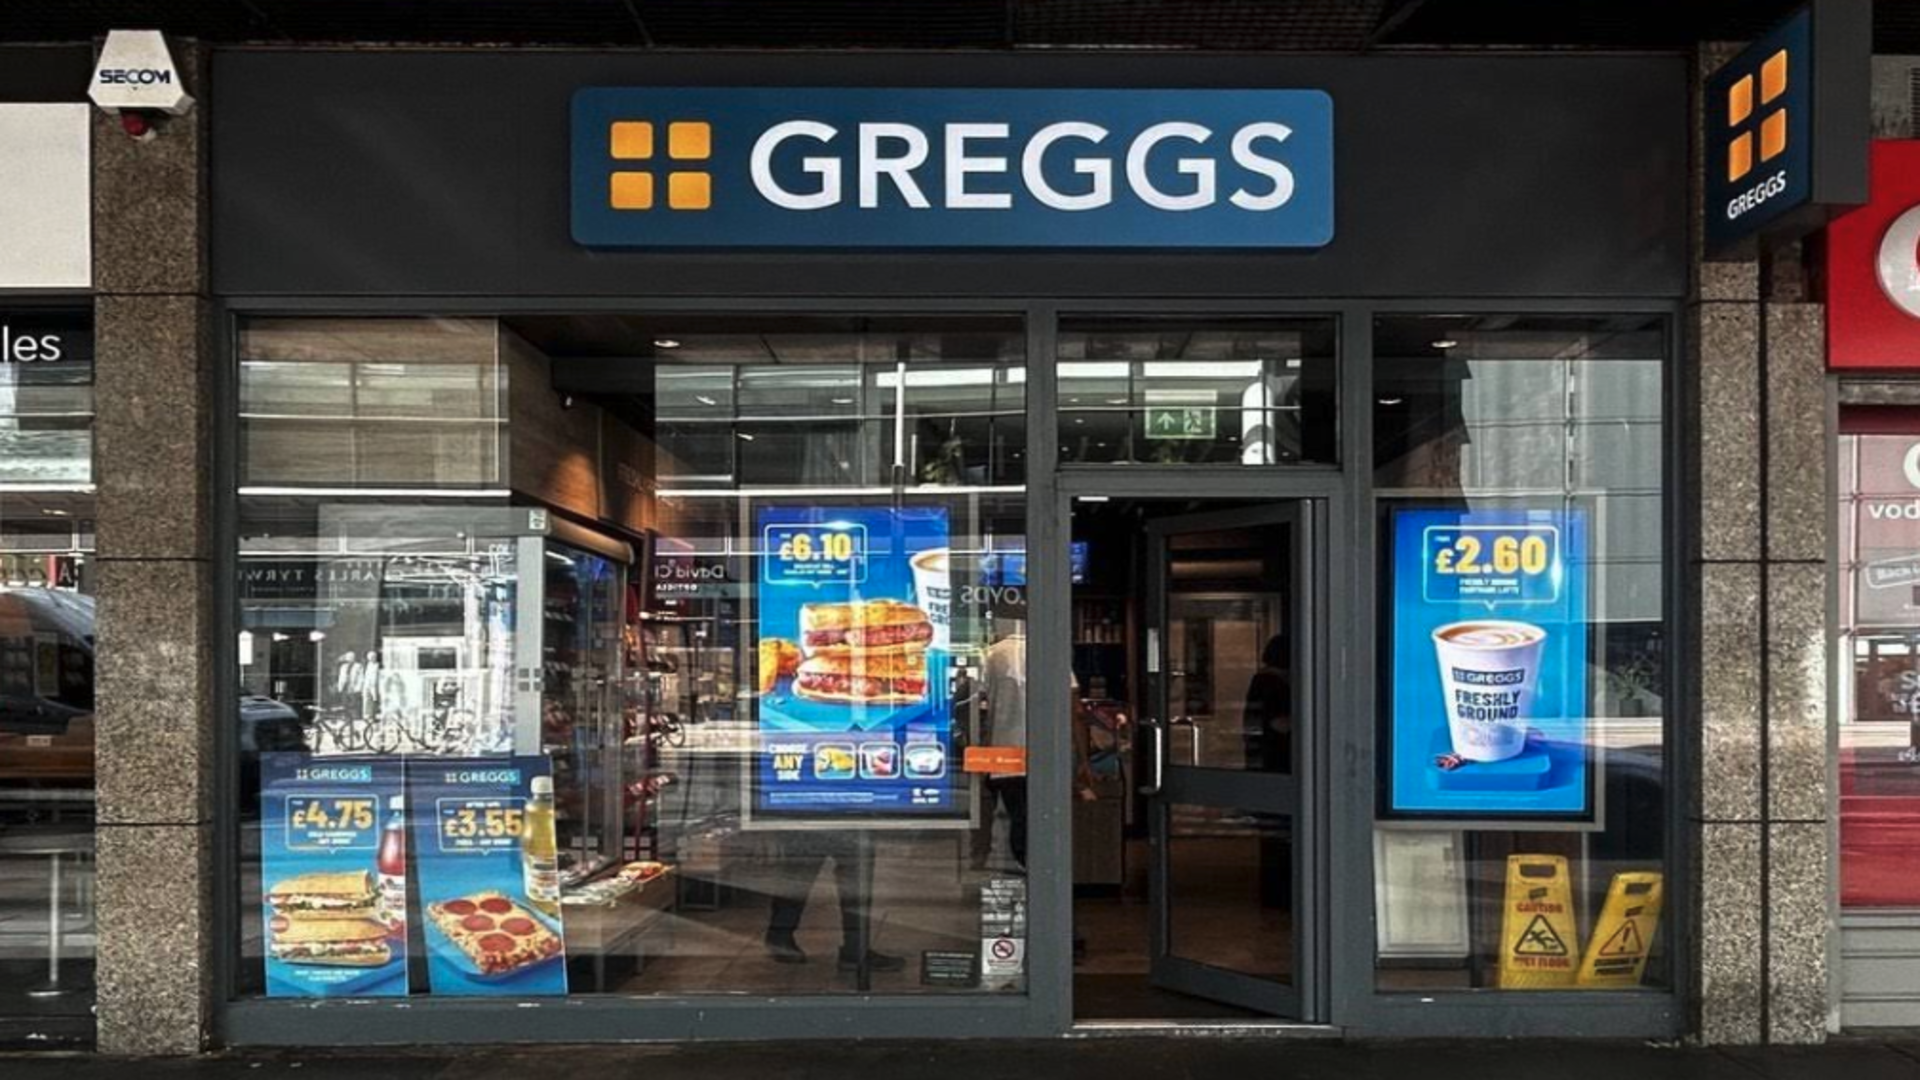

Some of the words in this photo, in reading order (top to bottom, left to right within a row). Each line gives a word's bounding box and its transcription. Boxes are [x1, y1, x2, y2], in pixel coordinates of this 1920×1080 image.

[99, 69, 171, 84] SECOM
[750, 120, 1295, 211] GREGGS
[1727, 170, 1786, 219] GREGGS
[3, 325, 61, 361] les
[780, 533, 851, 561] £6.10
[1435, 535, 1547, 575] £2.60
[1455, 689, 1521, 707] FRESHLY
[1457, 704, 1519, 721] GROUND
[310, 768, 369, 780] GREGGS
[459, 771, 518, 783] GREGGS
[292, 800, 373, 829] £4.75
[445, 809, 523, 837] £3.55
